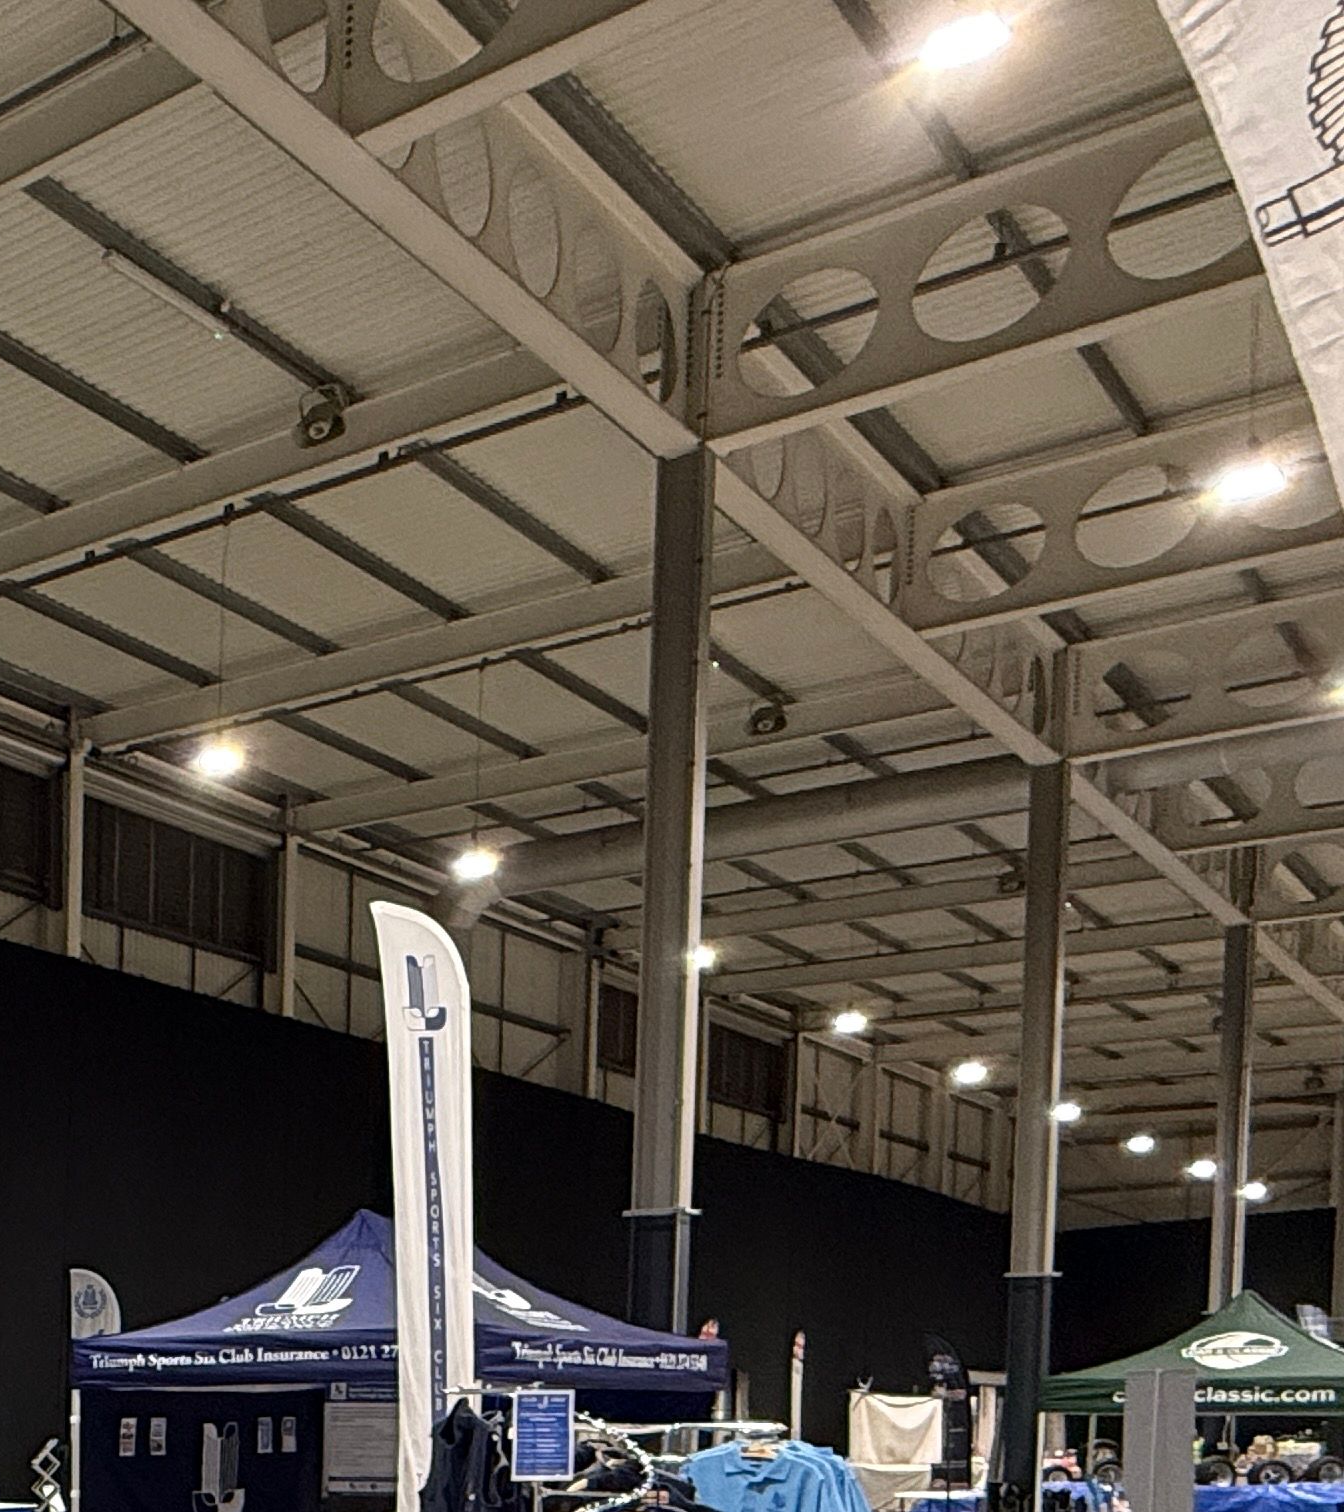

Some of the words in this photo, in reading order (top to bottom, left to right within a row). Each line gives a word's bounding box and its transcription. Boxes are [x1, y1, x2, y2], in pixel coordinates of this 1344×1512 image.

[422, 1040, 437, 1151] TRIUMPH
[430, 1172, 441, 1268] SPORTS
[433, 1285, 443, 1331] SIX
[89, 1353, 146, 1373] Triumph
[147, 1353, 192, 1371] Sports
[193, 1351, 217, 1365] Six
[218, 1348, 253, 1364] Club
[256, 1347, 327, 1362] Insurance
[341, 1345, 378, 1360] 0121
[433, 1350, 444, 1412] CLUB
